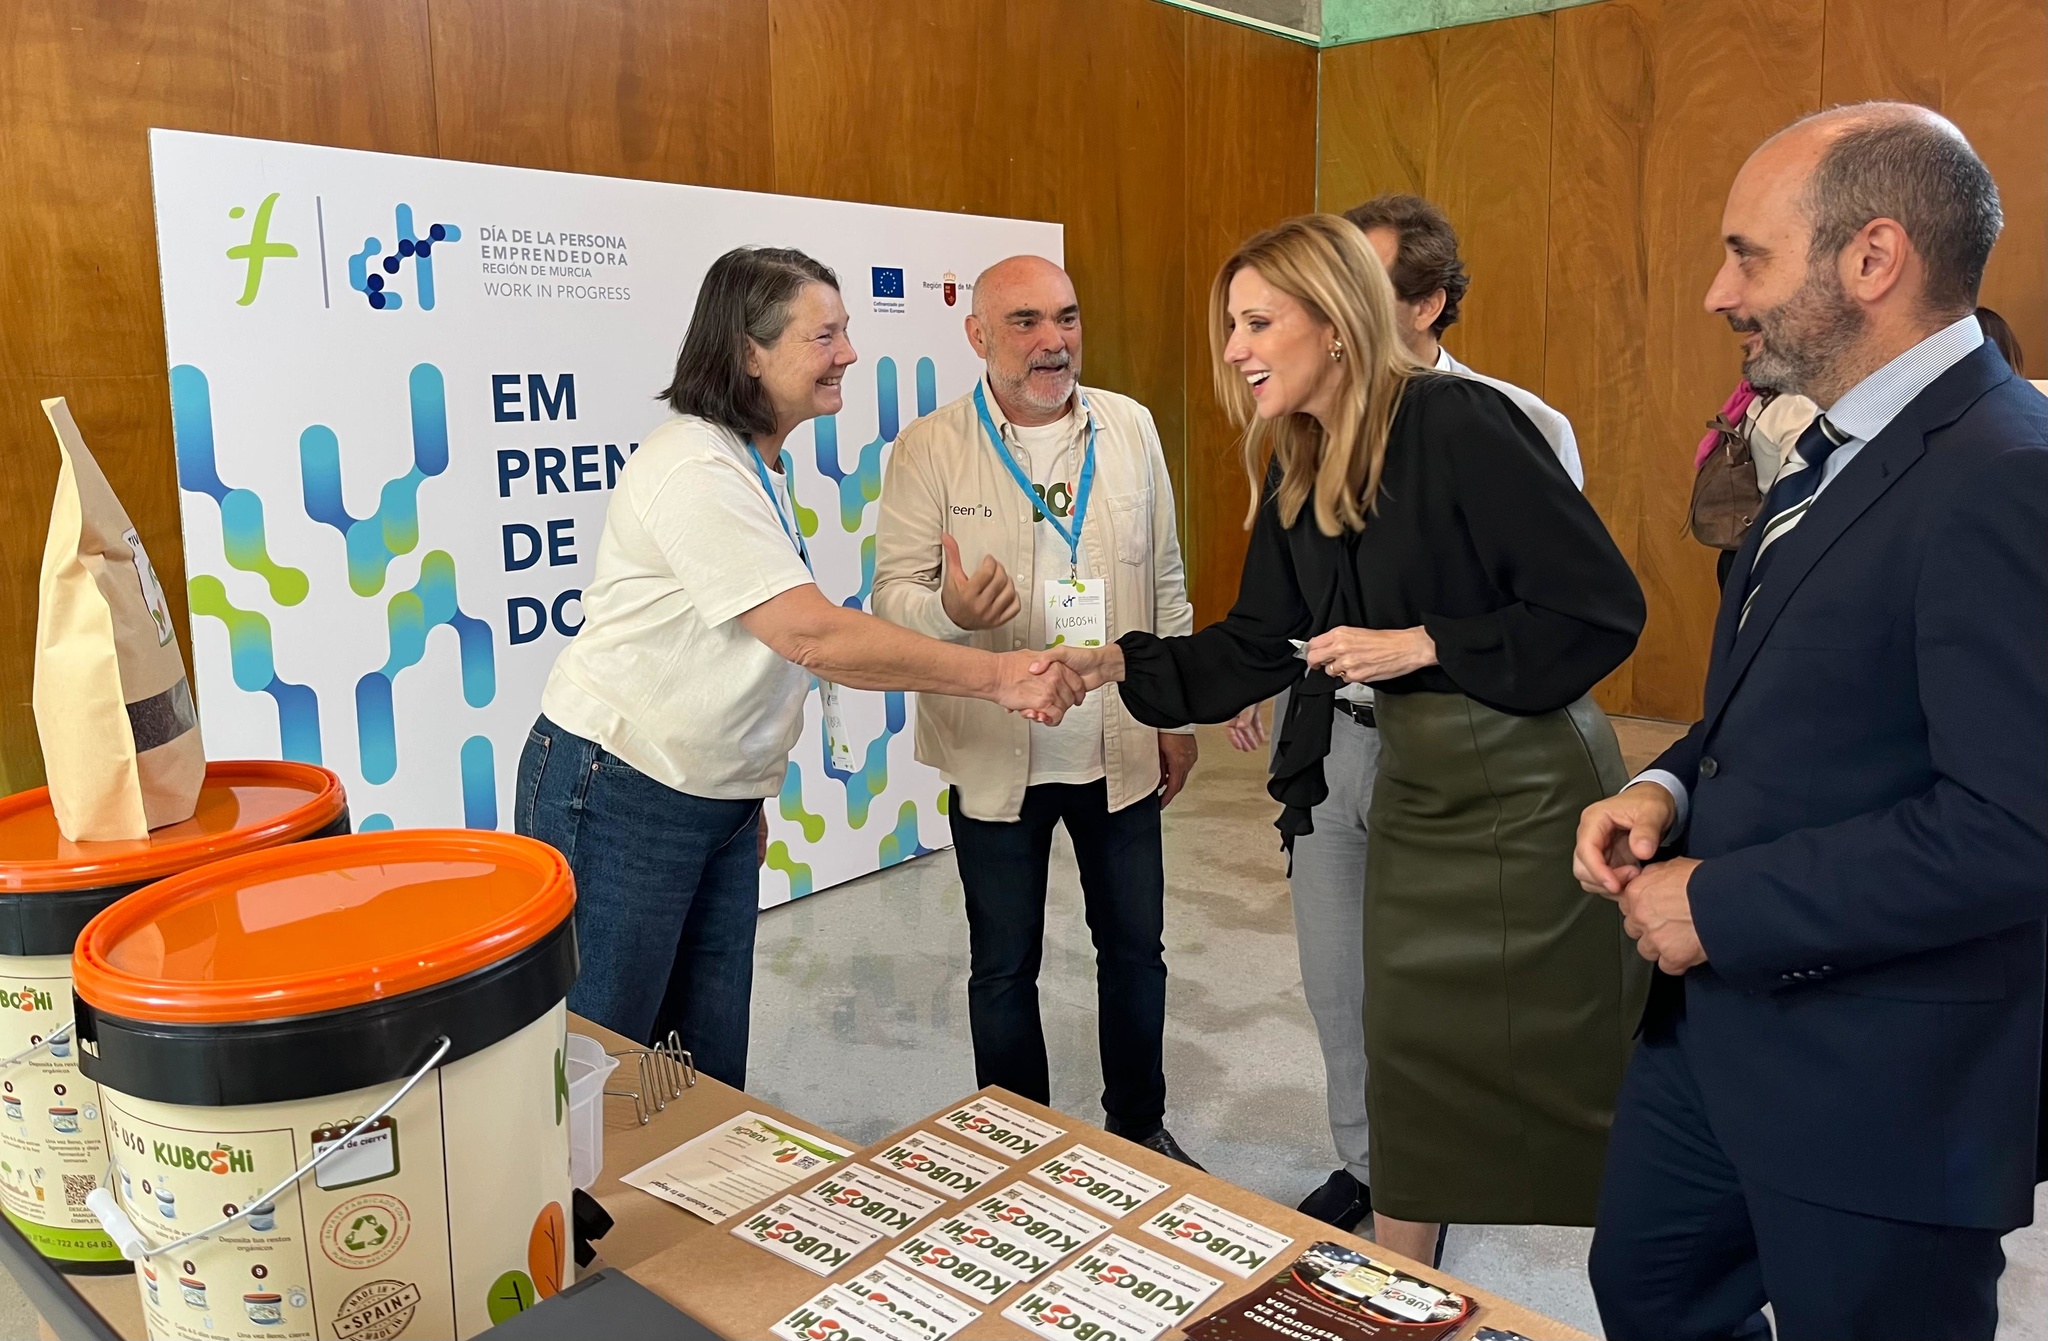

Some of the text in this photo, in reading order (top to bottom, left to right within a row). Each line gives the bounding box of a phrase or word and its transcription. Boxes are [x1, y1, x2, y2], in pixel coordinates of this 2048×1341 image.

[480, 225, 627, 250] DÍA DE LA PERSONA
[481, 245, 628, 266] EMPRENDEDORA
[482, 262, 592, 278] REGIÓN DE MURCIA
[484, 282, 631, 301] WORK IN PROGRESS
[923, 281, 942, 290] Región
[491, 373, 577, 423] EM
[502, 518, 578, 572] DE
[121, 1127, 145, 1155] USO
[346, 1140, 358, 1148] de
[360, 1133, 388, 1146] cierre
[56, 1239, 72, 1247] 722
[74, 1240, 84, 1248] 42
[101, 1240, 113, 1248] 83
[218, 1235, 251, 1244] Deposita
[349, 1288, 373, 1307] MADE
[1265, 1297, 1298, 1315] VIDA
[351, 1295, 403, 1329] SPAIN
[1254, 1303, 1274, 1315] EN
